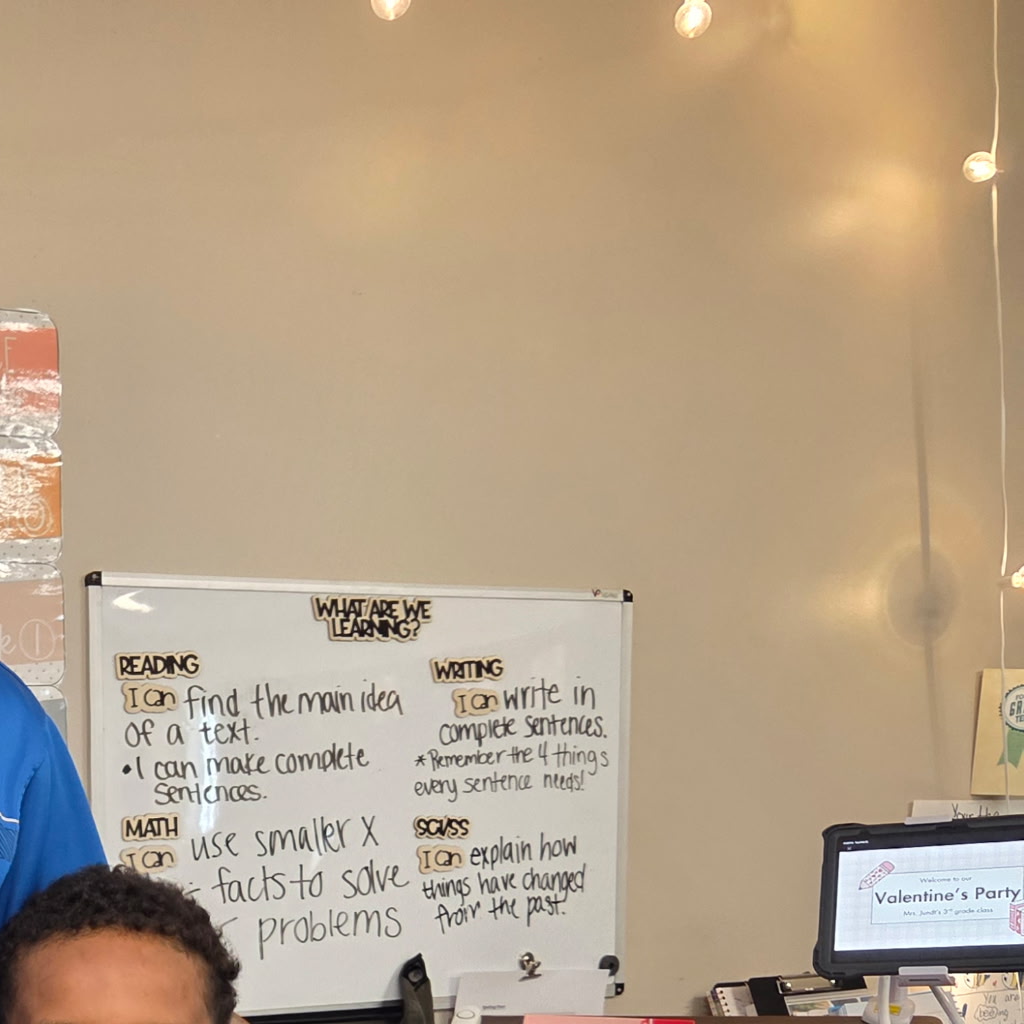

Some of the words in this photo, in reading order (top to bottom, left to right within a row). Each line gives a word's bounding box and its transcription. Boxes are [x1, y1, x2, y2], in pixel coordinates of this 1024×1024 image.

[316, 598, 366, 618] WHAT
[370, 600, 400, 619] ARE
[403, 599, 431, 620] WE
[332, 618, 421, 638] LEARNING?
[120, 655, 199, 676] READING
[434, 658, 504, 680] WRITING
[128, 688, 139, 708] I
[143, 688, 177, 707] can
[183, 685, 240, 719] find
[251, 682, 294, 719] the
[298, 686, 354, 714] main
[361, 680, 404, 716] idea
[458, 694, 467, 713] I
[471, 693, 498, 710] can
[504, 677, 563, 710] write
[573, 676, 596, 710] in
[1009, 700, 1024, 717] GR
[167, 724, 184, 745] a
[199, 718, 260, 745] text.
[154, 761, 198, 780] can
[207, 753, 270, 776] make
[275, 742, 370, 775] complete
[506, 746, 534, 764] the
[538, 741, 548, 766] 4
[552, 742, 610, 776] things
[414, 779, 458, 803] every
[462, 772, 534, 793] sentence
[126, 816, 179, 838] MATH
[141, 851, 175, 869] can
[191, 831, 240, 862] use
[255, 816, 352, 857] smaller
[422, 850, 431, 869] I
[435, 850, 463, 867] can
[470, 836, 533, 871] explain
[539, 832, 577, 861] how
[211, 866, 286, 904] facts
[289, 864, 323, 900] to
[341, 859, 410, 899] solve
[422, 876, 472, 907] things
[478, 872, 518, 895] have
[522, 863, 586, 903] changed
[975, 886, 1022, 903] Party
[488, 896, 520, 921] the
[527, 894, 567, 927] past.
[954, 907, 975, 915] grade
[258, 906, 403, 960] problems
